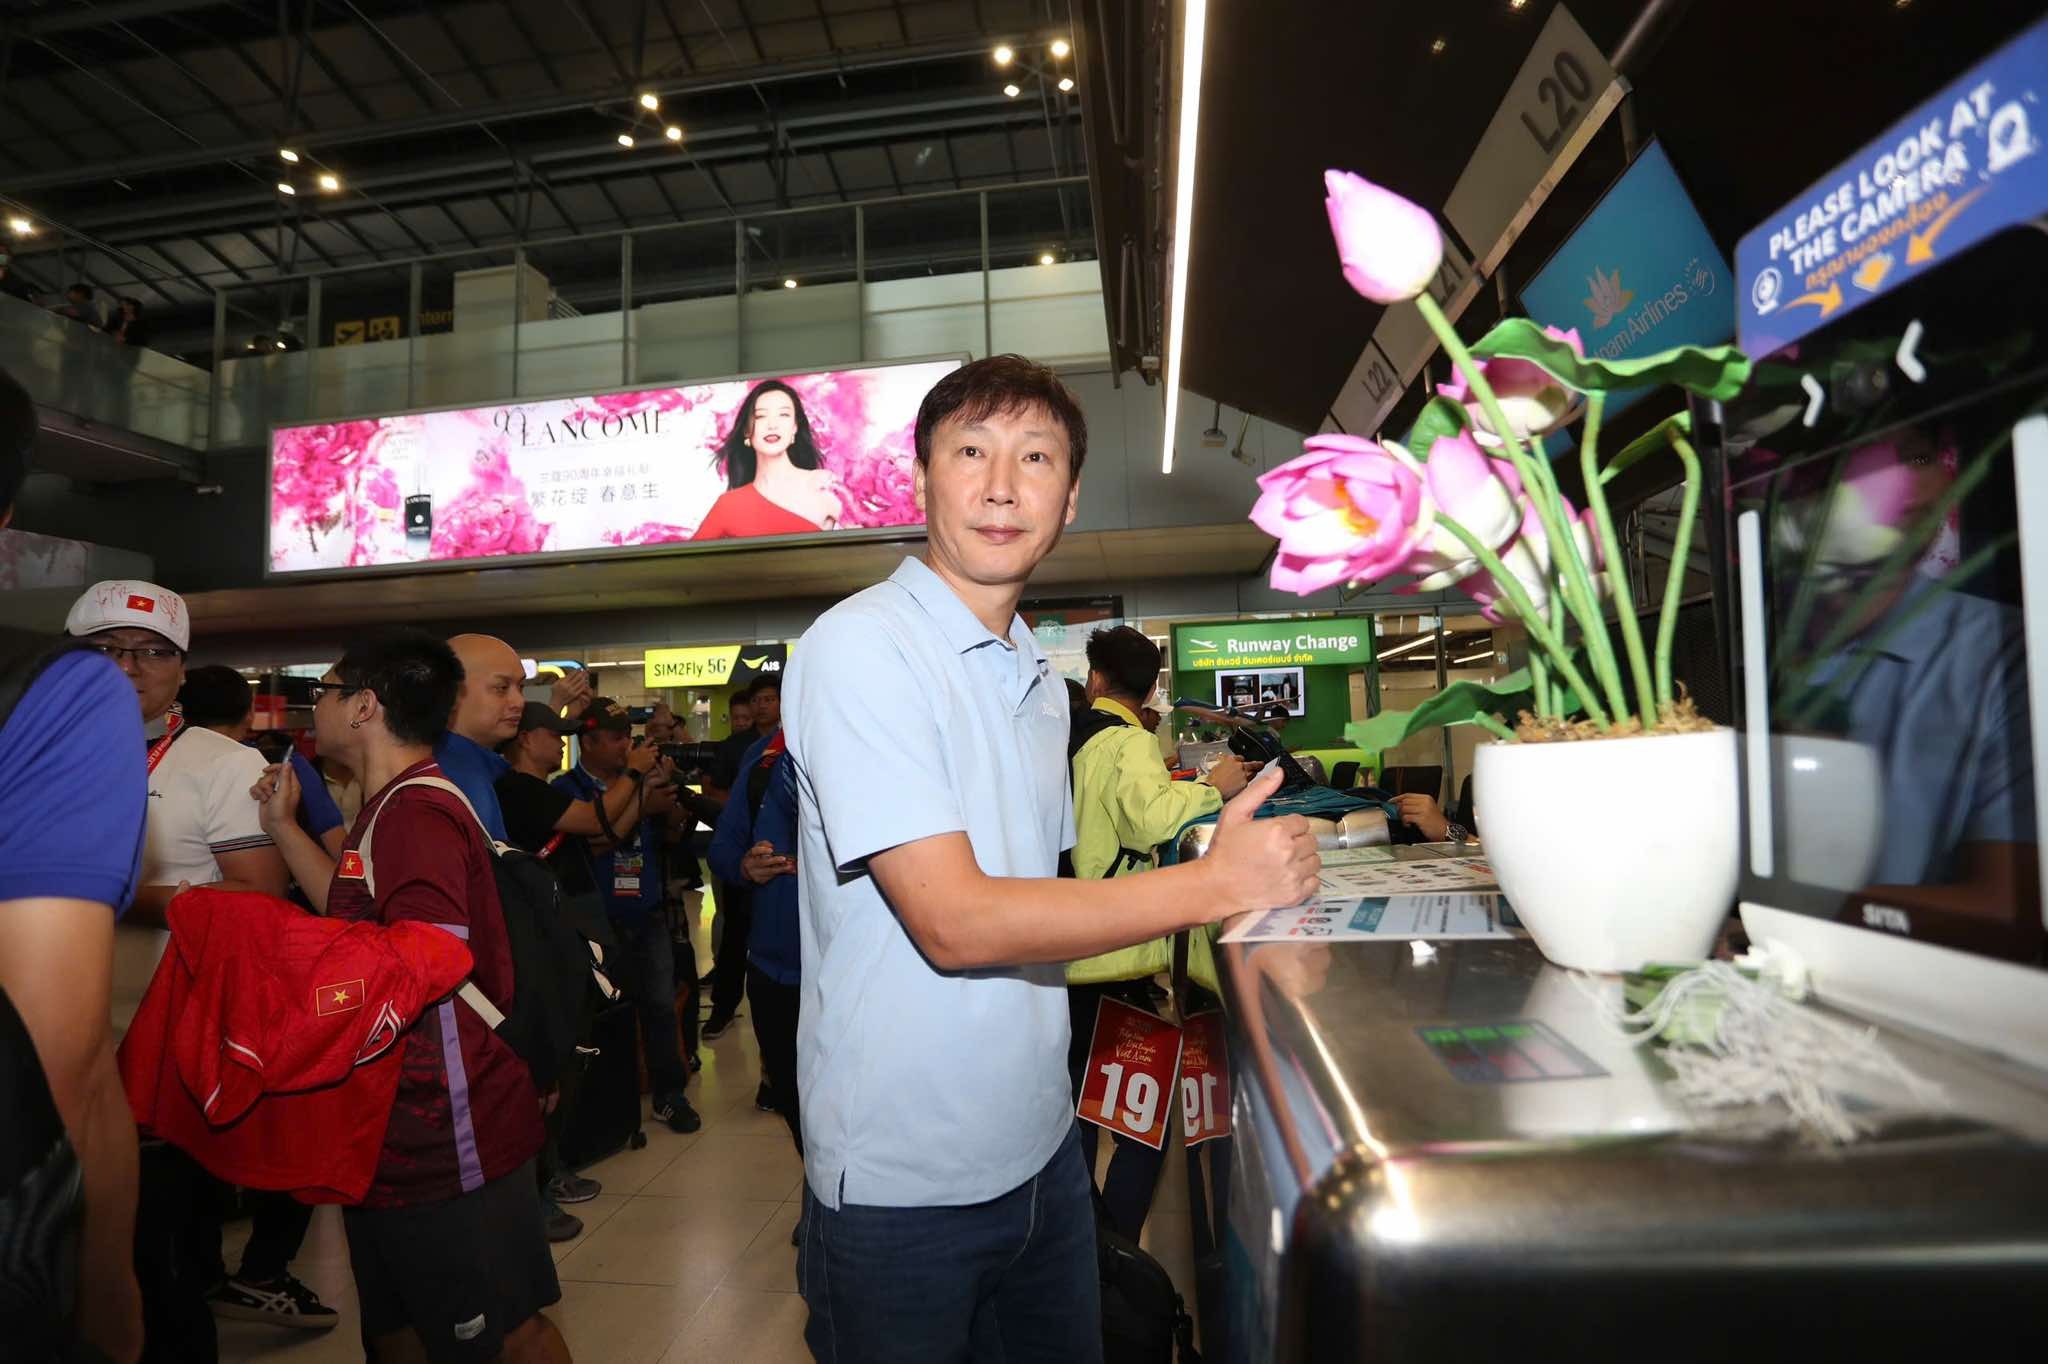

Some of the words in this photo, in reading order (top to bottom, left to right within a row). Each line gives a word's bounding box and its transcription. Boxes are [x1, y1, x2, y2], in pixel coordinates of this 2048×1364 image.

[1520, 51, 1592, 155] L20
[1768, 182, 1854, 260] PLEASE
[1859, 116, 1945, 199] LOOK
[1949, 80, 1995, 139] AT
[1789, 226, 1836, 275] THE
[1840, 141, 1970, 242] CAMERA
[1628, 283, 1689, 342] Airlines
[1361, 360, 1393, 404] L22
[654, 660, 703, 678] SIM2Fly
[707, 658, 727, 674] 5G
[761, 661, 780, 672] AIS
[1227, 638, 1291, 654] Runway
[1295, 634, 1358, 652] Change
[1100, 1062, 1160, 1134] 19
